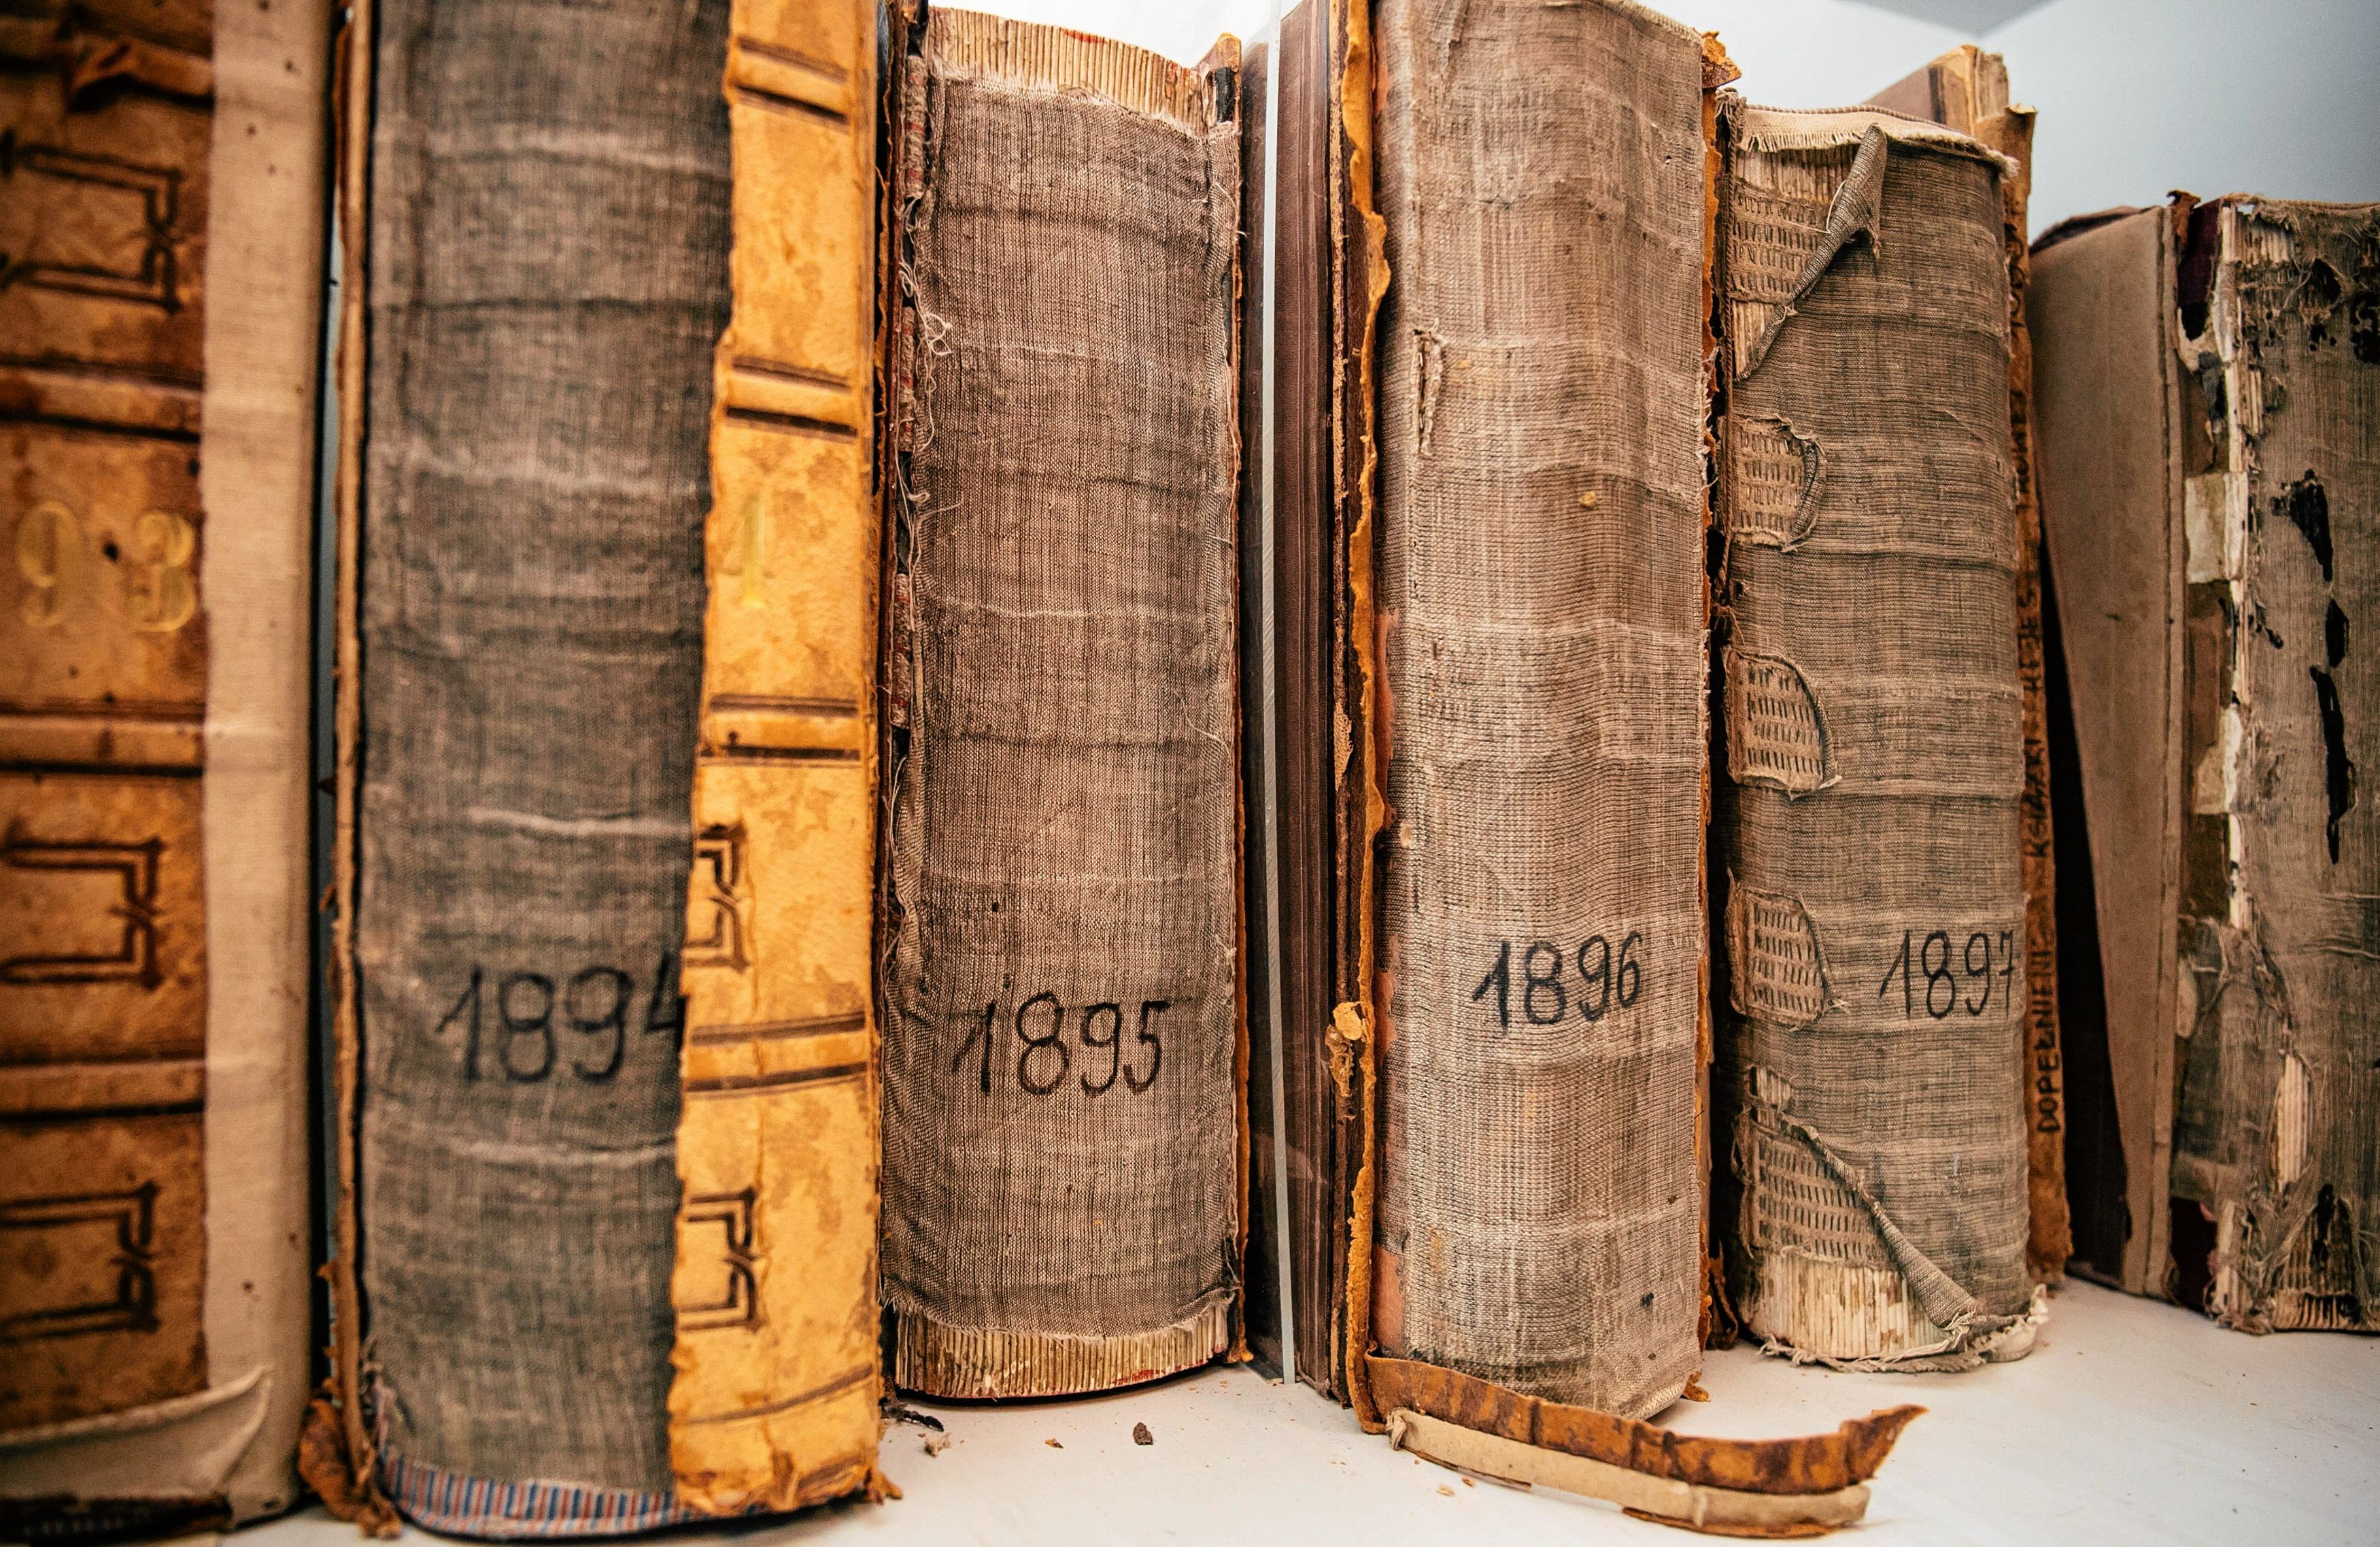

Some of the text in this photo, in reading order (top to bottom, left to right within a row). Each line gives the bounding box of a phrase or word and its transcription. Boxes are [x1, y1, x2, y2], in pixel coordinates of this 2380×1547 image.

[436, 953, 690, 1084] 1894
[1472, 930, 1642, 1034] 1896
[1879, 929, 2015, 1020] 1897
[953, 991, 1172, 1096] 1895
